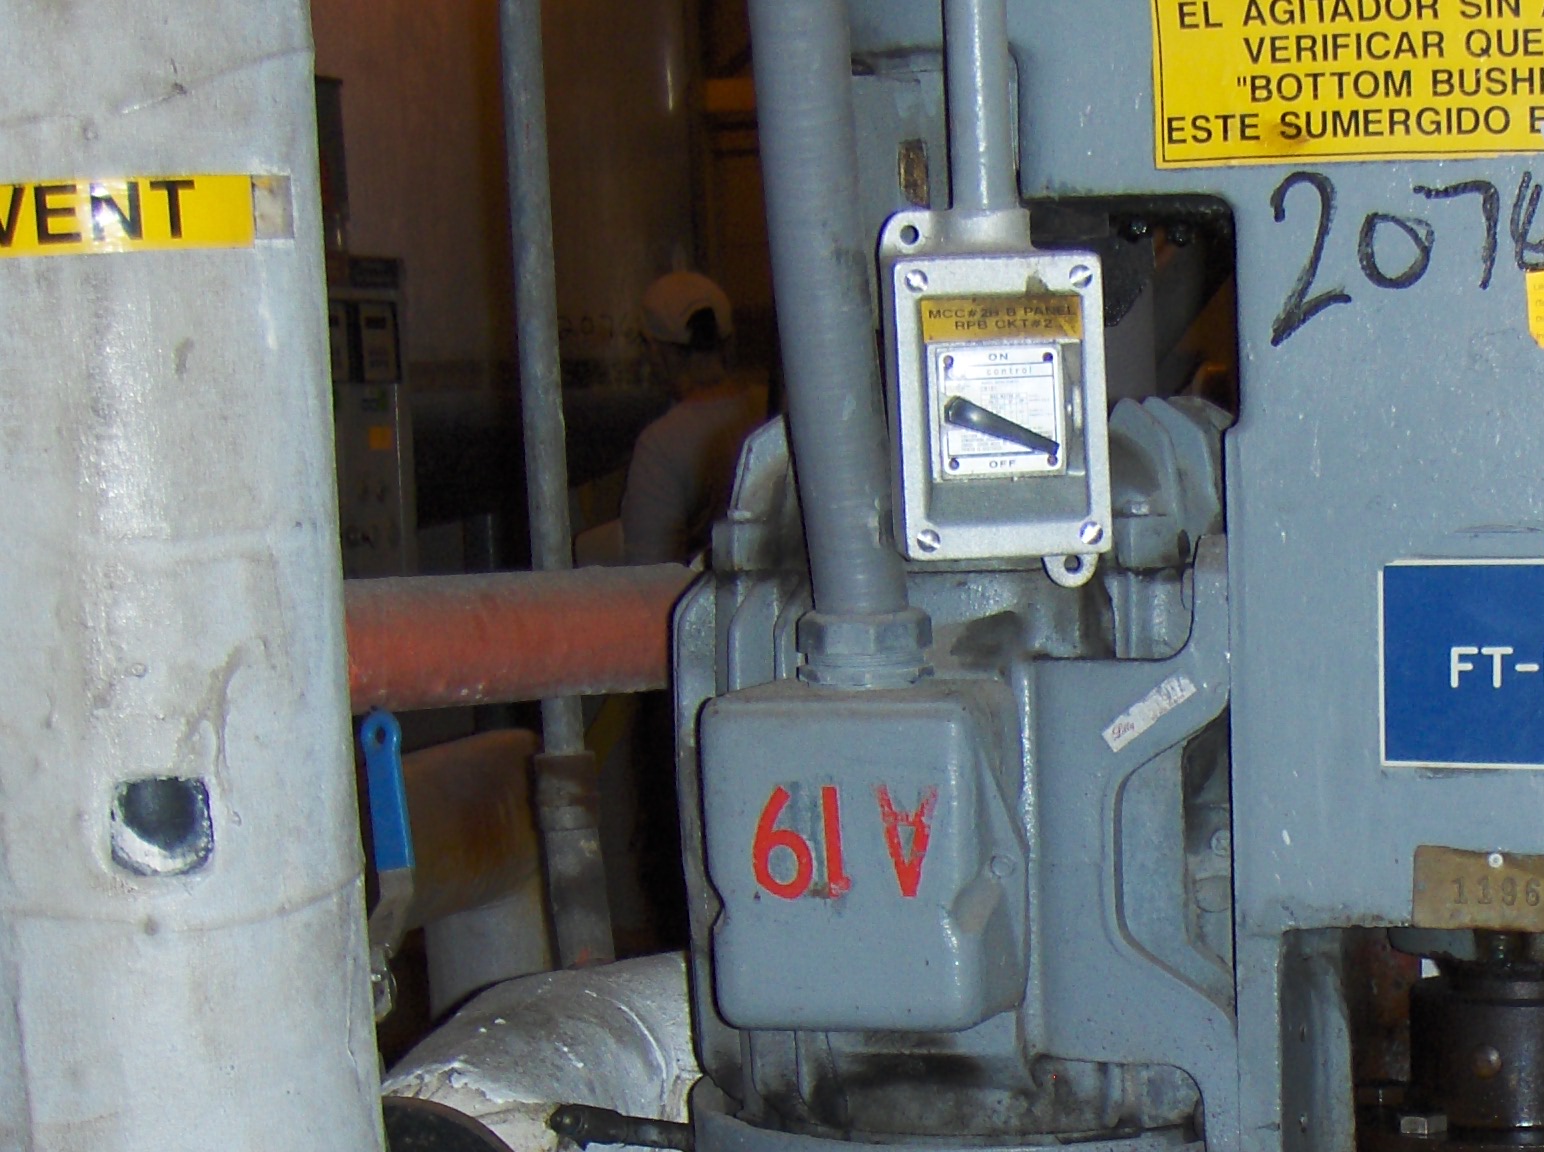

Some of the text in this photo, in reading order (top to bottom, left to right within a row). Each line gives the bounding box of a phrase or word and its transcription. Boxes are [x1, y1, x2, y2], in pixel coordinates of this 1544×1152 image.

[1178, 1, 1223, 29] EL
[1243, 0, 1439, 27] AGITADOR
[1460, 0, 1521, 19] SIN
[1243, 31, 1444, 64] VERIFICAR
[1465, 28, 1544, 58] QUE
[1237, 70, 1411, 103] "BOTTOM
[1167, 113, 1260, 144] ESTE
[1280, 106, 1510, 141] SUMERGIDO
[0, 178, 196, 248] VENT
[954, 319, 989, 330] RPB
[986, 366, 1032, 375] control
[988, 352, 1008, 361] ON
[989, 460, 1016, 468] OFF
